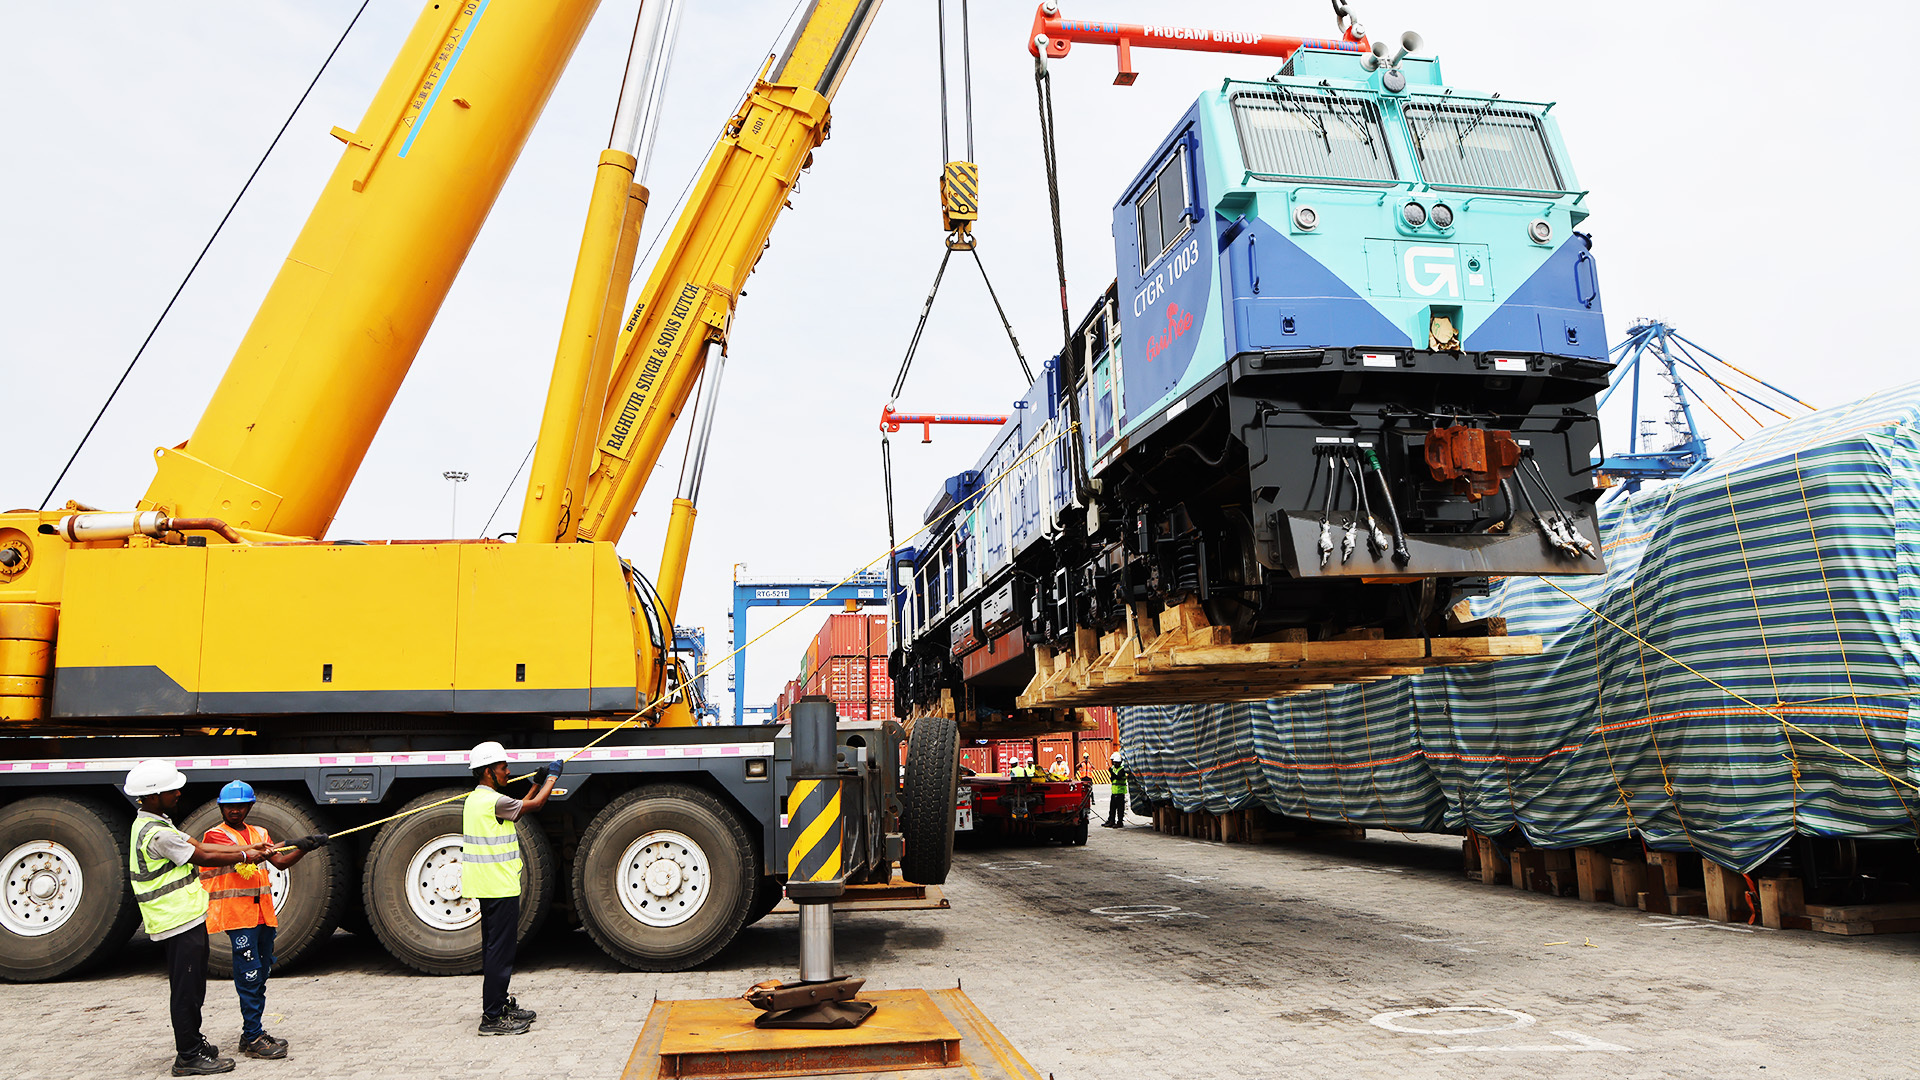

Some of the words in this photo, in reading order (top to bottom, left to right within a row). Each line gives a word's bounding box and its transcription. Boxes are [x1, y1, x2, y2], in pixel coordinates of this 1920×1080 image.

[1143, 25, 1208, 41] PROCAM
[1213, 30, 1263, 44] GROUP
[1134, 273, 1165, 318] CTGR
[1167, 239, 1199, 286] 1003
[671, 282, 700, 320] KUTCH
[657, 318, 682, 349] SONS
[652, 347, 669, 359] &
[635, 355, 664, 393] SINGH
[606, 391, 646, 451] RAGHUVIR
[756, 589, 789, 597] RTG-521E
